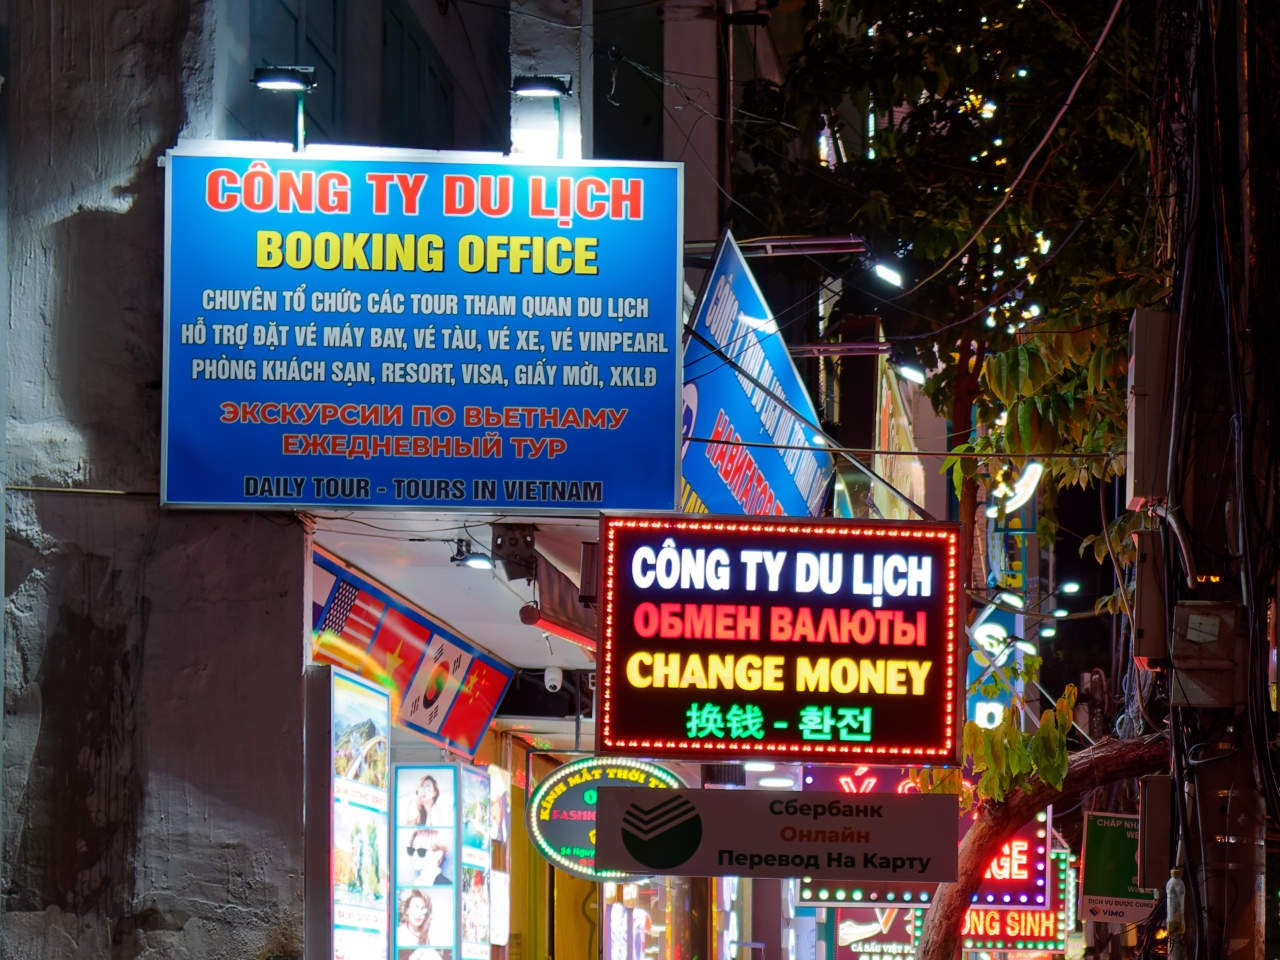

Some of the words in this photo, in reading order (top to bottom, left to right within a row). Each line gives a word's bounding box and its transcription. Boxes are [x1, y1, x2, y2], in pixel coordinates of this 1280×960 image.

[206, 162, 351, 214] CÔNG
[367, 174, 426, 216] TY
[444, 174, 511, 217] DU
[531, 177, 643, 228] LỊCH
[256, 230, 445, 272] BOOKING
[458, 234, 598, 275] OFFICE
[202, 285, 277, 312] CHUYÊN
[282, 284, 305, 312] TỔ
[312, 288, 361, 314] CHỨC
[367, 289, 404, 314] CÁC
[411, 295, 458, 315] TOUR
[464, 296, 515, 316] THAM
[522, 296, 573, 318] QUAN
[578, 297, 602, 317] DU
[608, 297, 648, 320] LỊCH
[181, 317, 207, 345] HỖ
[213, 325, 248, 348] TRỢ
[253, 324, 288, 348] ĐẶT
[295, 325, 317, 345] VÉ
[323, 326, 364, 348] MÁY
[370, 329, 408, 352] BAY,
[413, 327, 435, 349] VÉ
[442, 328, 483, 352] TÀU,
[488, 329, 510, 351] VÉ
[515, 332, 545, 354] XE,
[551, 329, 573, 352] VÉ
[579, 332, 668, 353] VINPEARL
[192, 357, 256, 381] PHÒNG
[262, 358, 325, 382] KHÁCH
[330, 363, 375, 388] SẠN,
[381, 365, 456, 387] RESORT,
[462, 366, 508, 387] VISA,
[514, 358, 557, 386] GIẤY
[563, 362, 604, 388] MỜI,
[610, 368, 657, 388] XKLĐ
[220, 402, 402, 425] ЭКСКУРСИИ
[411, 406, 454, 427] ПО
[464, 406, 628, 429] ВЬЕТНАМУ
[282, 432, 502, 459] ЕЖЕДНЕВНЫЙ
[510, 438, 567, 459] ТУР
[244, 476, 305, 498] DAILY
[313, 477, 370, 498] TOUR
[394, 479, 465, 500] TOURS
[473, 479, 496, 501] IN
[502, 480, 603, 502] VIETNAM
[632, 538, 730, 590] CÔNG
[740, 551, 787, 592] TY
[795, 553, 842, 594] DU
[852, 554, 932, 607] LỊCH
[633, 602, 760, 640] ОБМЕН
[770, 606, 927, 646] ВАЛЮТЫ
[626, 652, 785, 691] CHANGE
[796, 657, 932, 695] MONEY
[686, 702, 765, 739] 换钱
[799, 706, 872, 742] 환전
[769, 800, 883, 819] Сбербанк
[779, 824, 871, 844] Онлайн
[718, 850, 820, 870] Перевод
[827, 853, 856, 868] На
[863, 853, 931, 874] Карту
[1006, 911, 1054, 936] SINH
